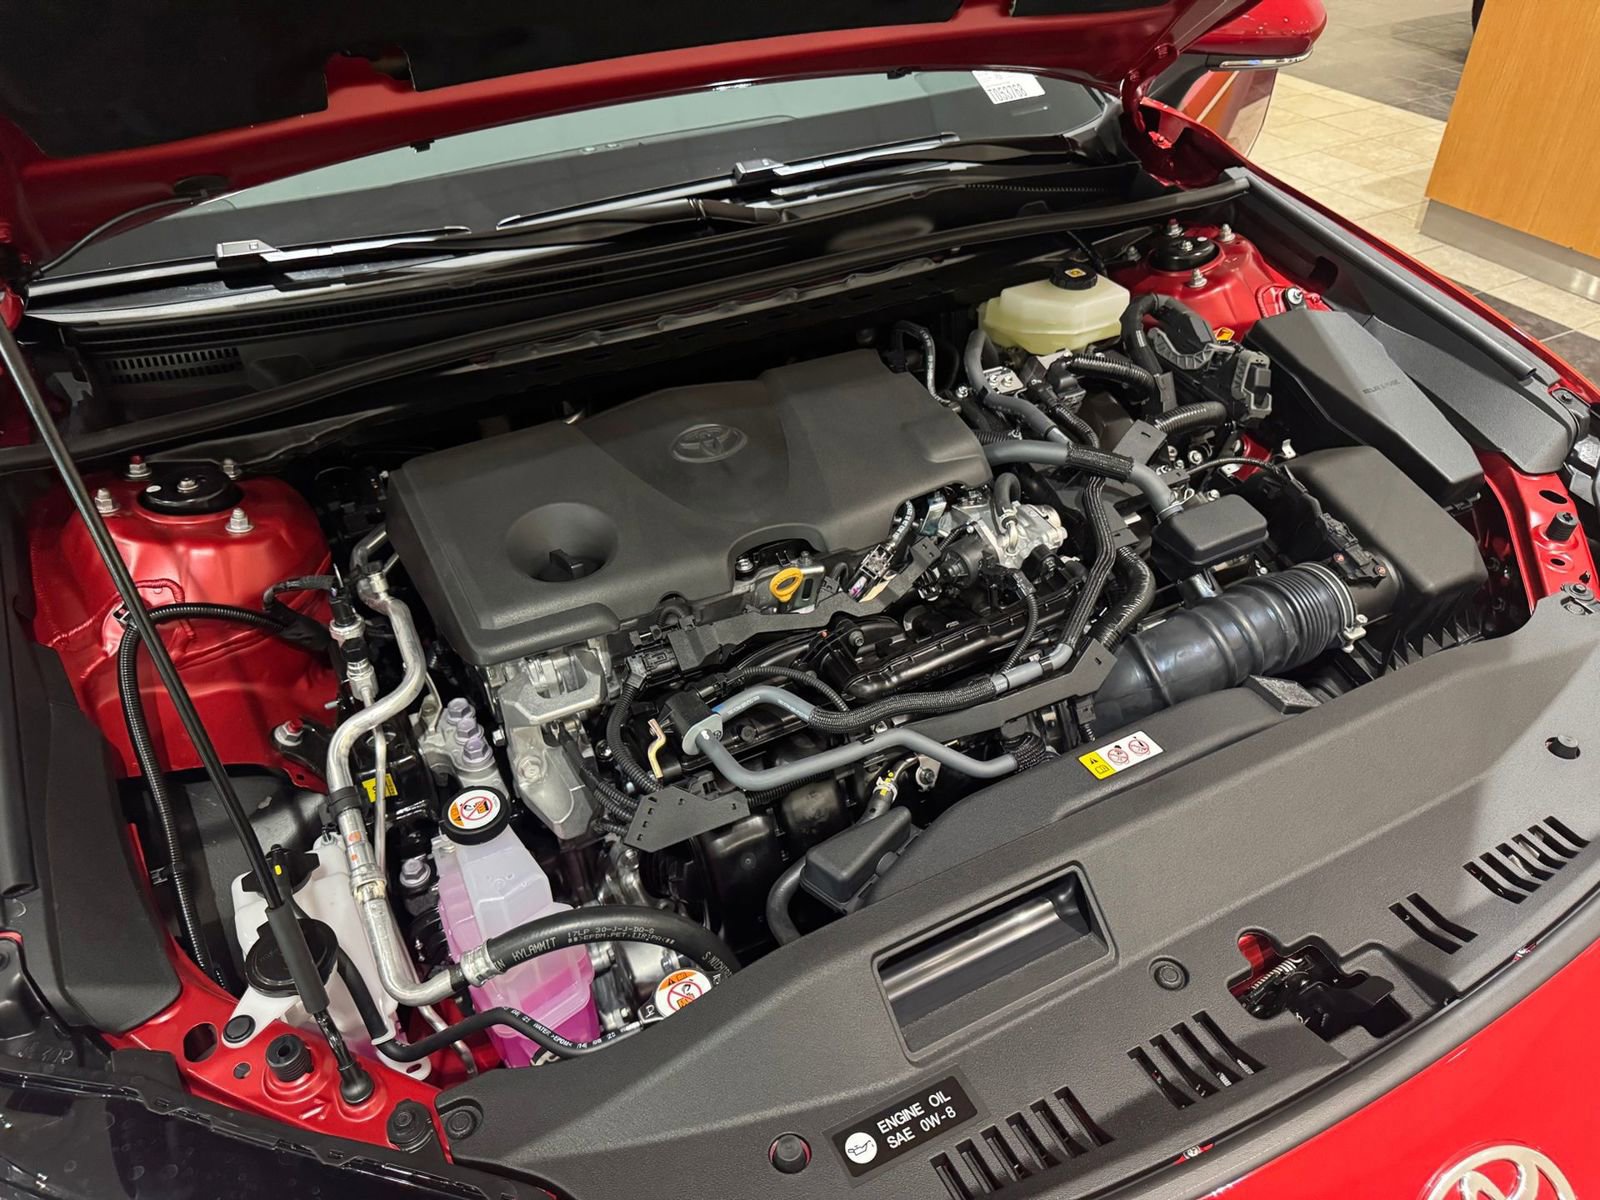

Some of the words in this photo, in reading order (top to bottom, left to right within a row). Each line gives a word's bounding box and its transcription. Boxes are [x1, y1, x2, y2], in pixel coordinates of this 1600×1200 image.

[511, 936, 557, 962] HYLAMMIT
[876, 1102, 925, 1134] ENGINE
[928, 1090, 952, 1108] OIL
[886, 1126, 916, 1149] SAE
[919, 1106, 957, 1132] 0W-8
